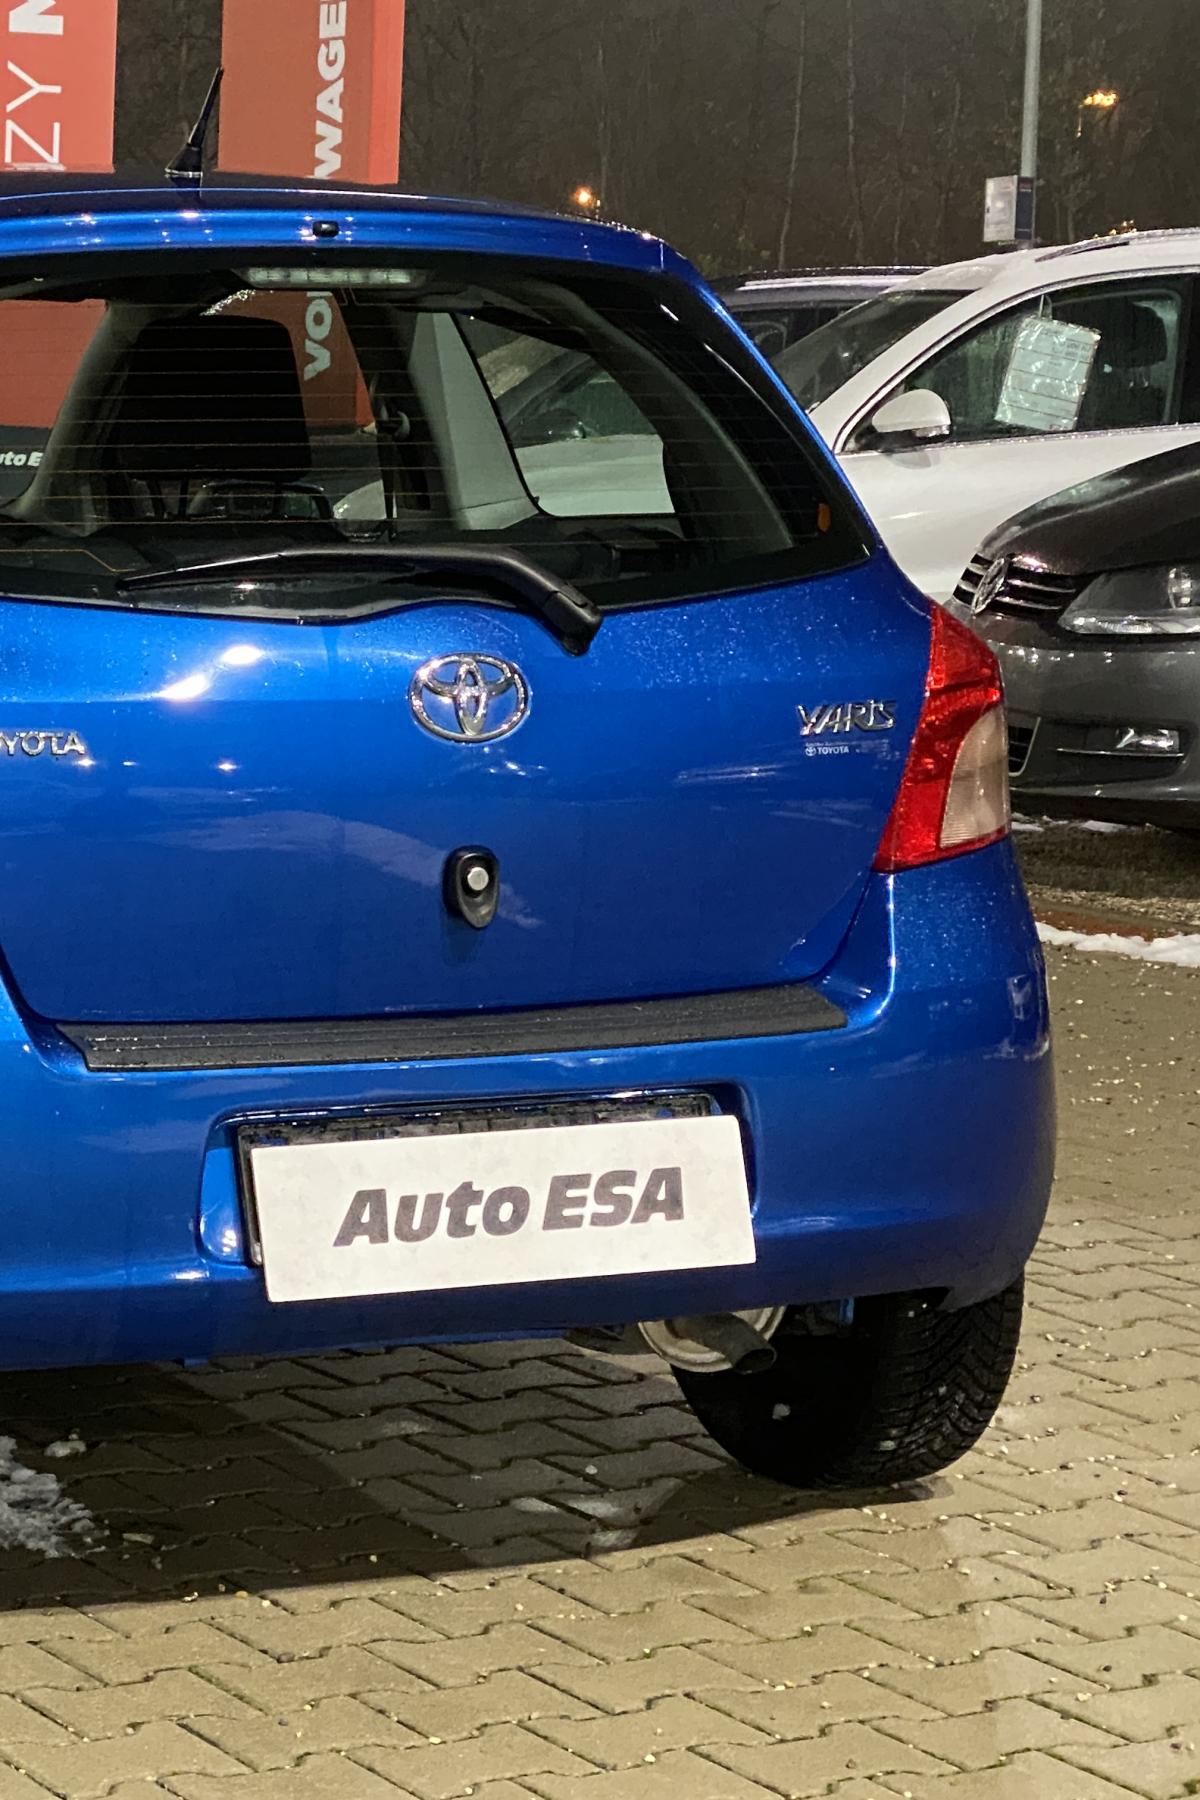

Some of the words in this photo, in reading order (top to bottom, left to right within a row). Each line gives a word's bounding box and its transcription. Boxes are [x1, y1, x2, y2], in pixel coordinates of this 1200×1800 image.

[817, 745, 850, 755] TOYOTA
[333, 1181, 531, 1248] Auto
[542, 1166, 685, 1231] ESA
